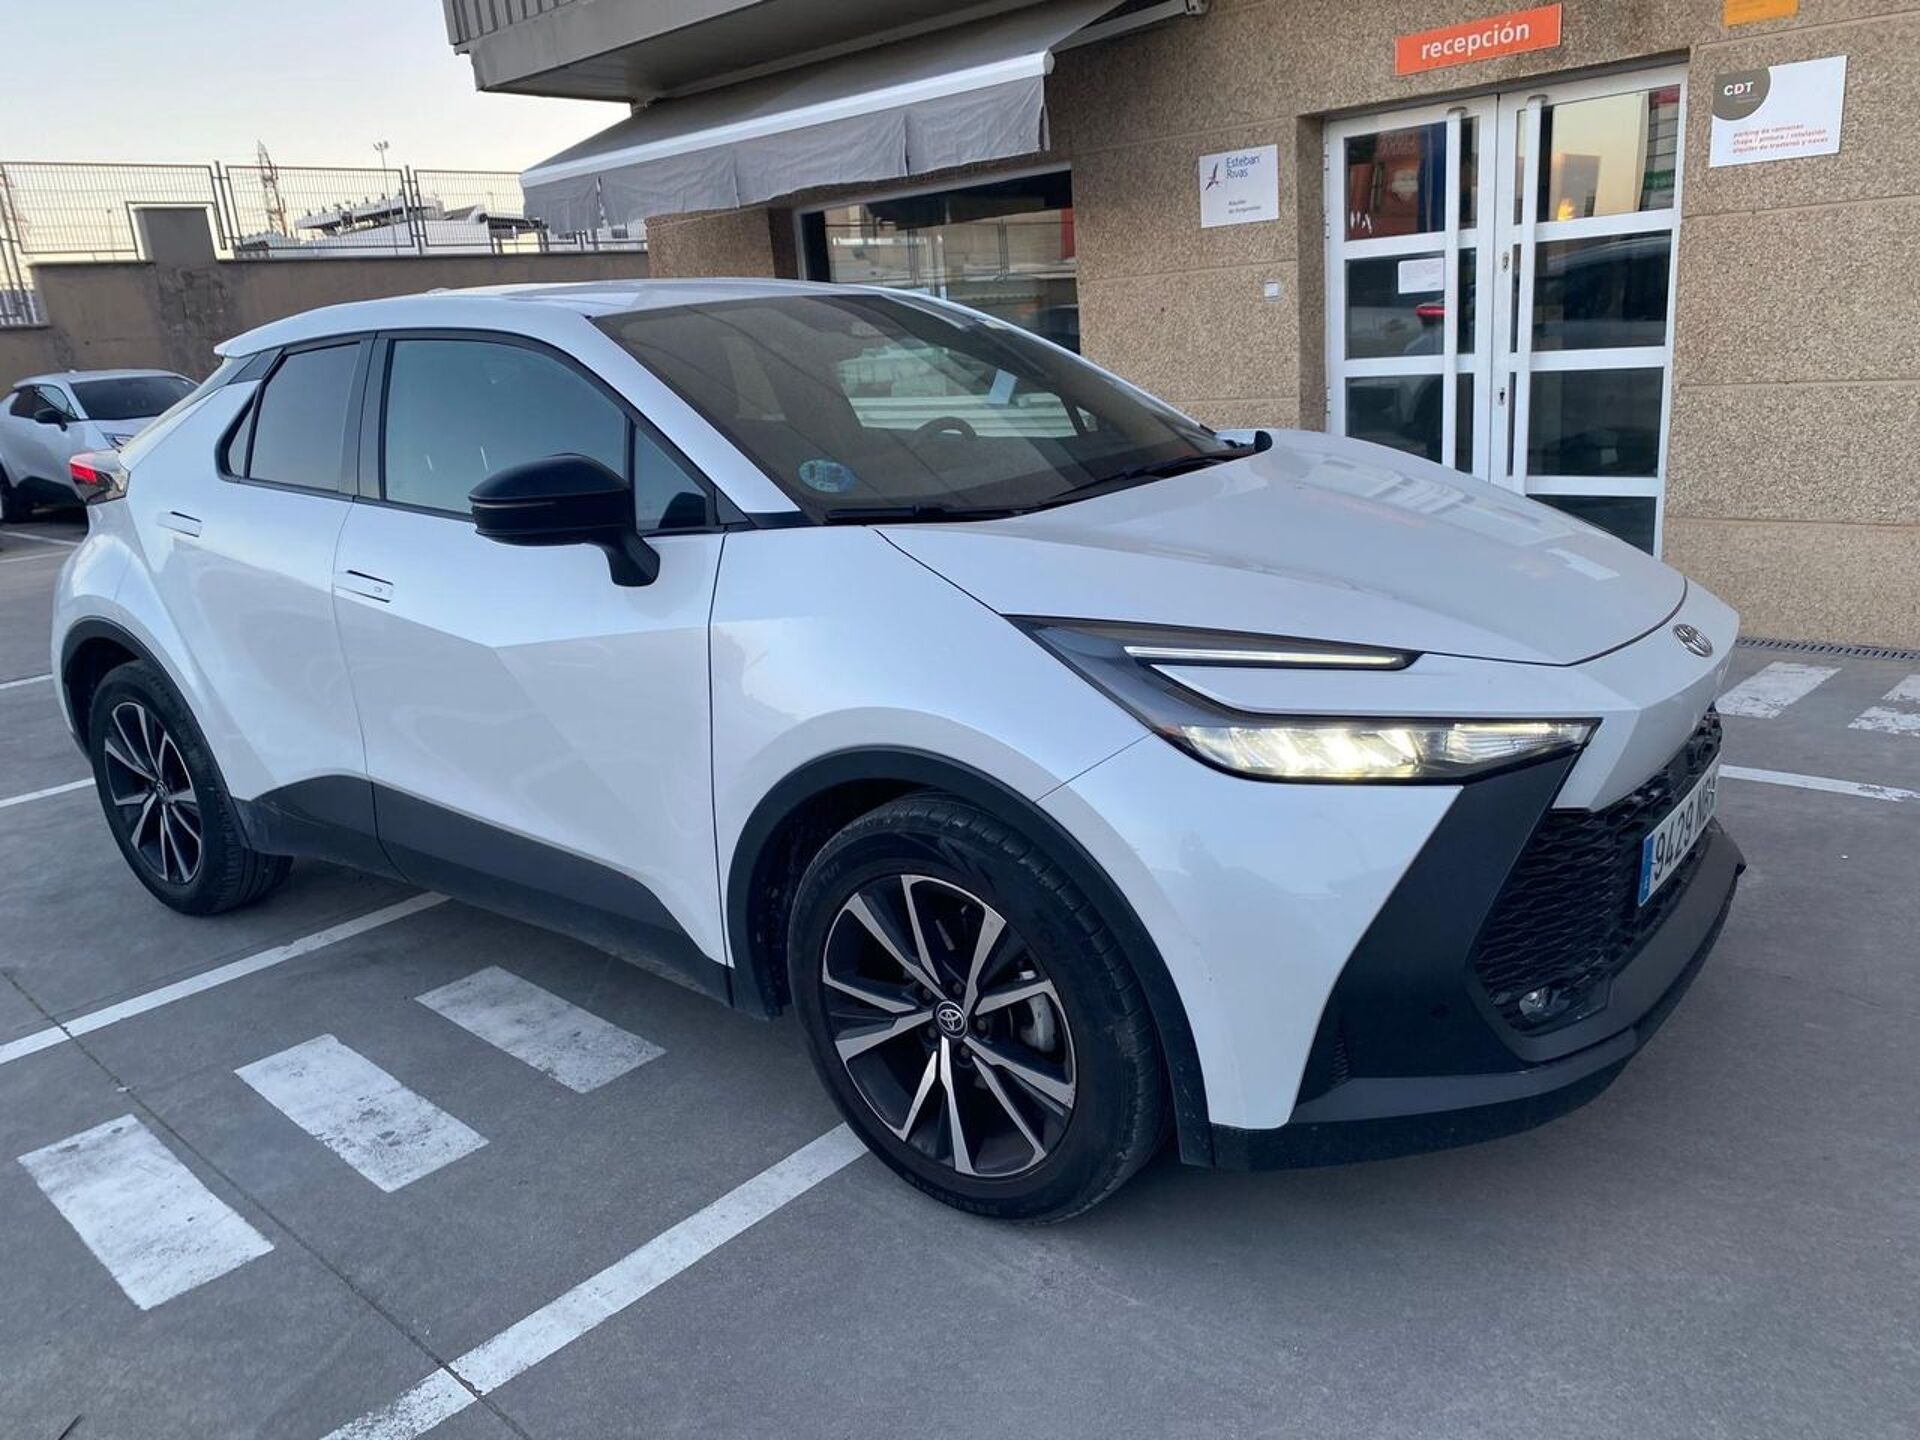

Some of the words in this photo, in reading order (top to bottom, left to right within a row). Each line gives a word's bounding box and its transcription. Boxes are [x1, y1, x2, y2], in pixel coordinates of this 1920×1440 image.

[1421, 22, 1530, 60] recepción
[1723, 82, 1754, 96] CDT
[1226, 155, 1261, 167] Esteban
[1226, 167, 1249, 179] Rivas
[1654, 802, 1693, 881] 9429
